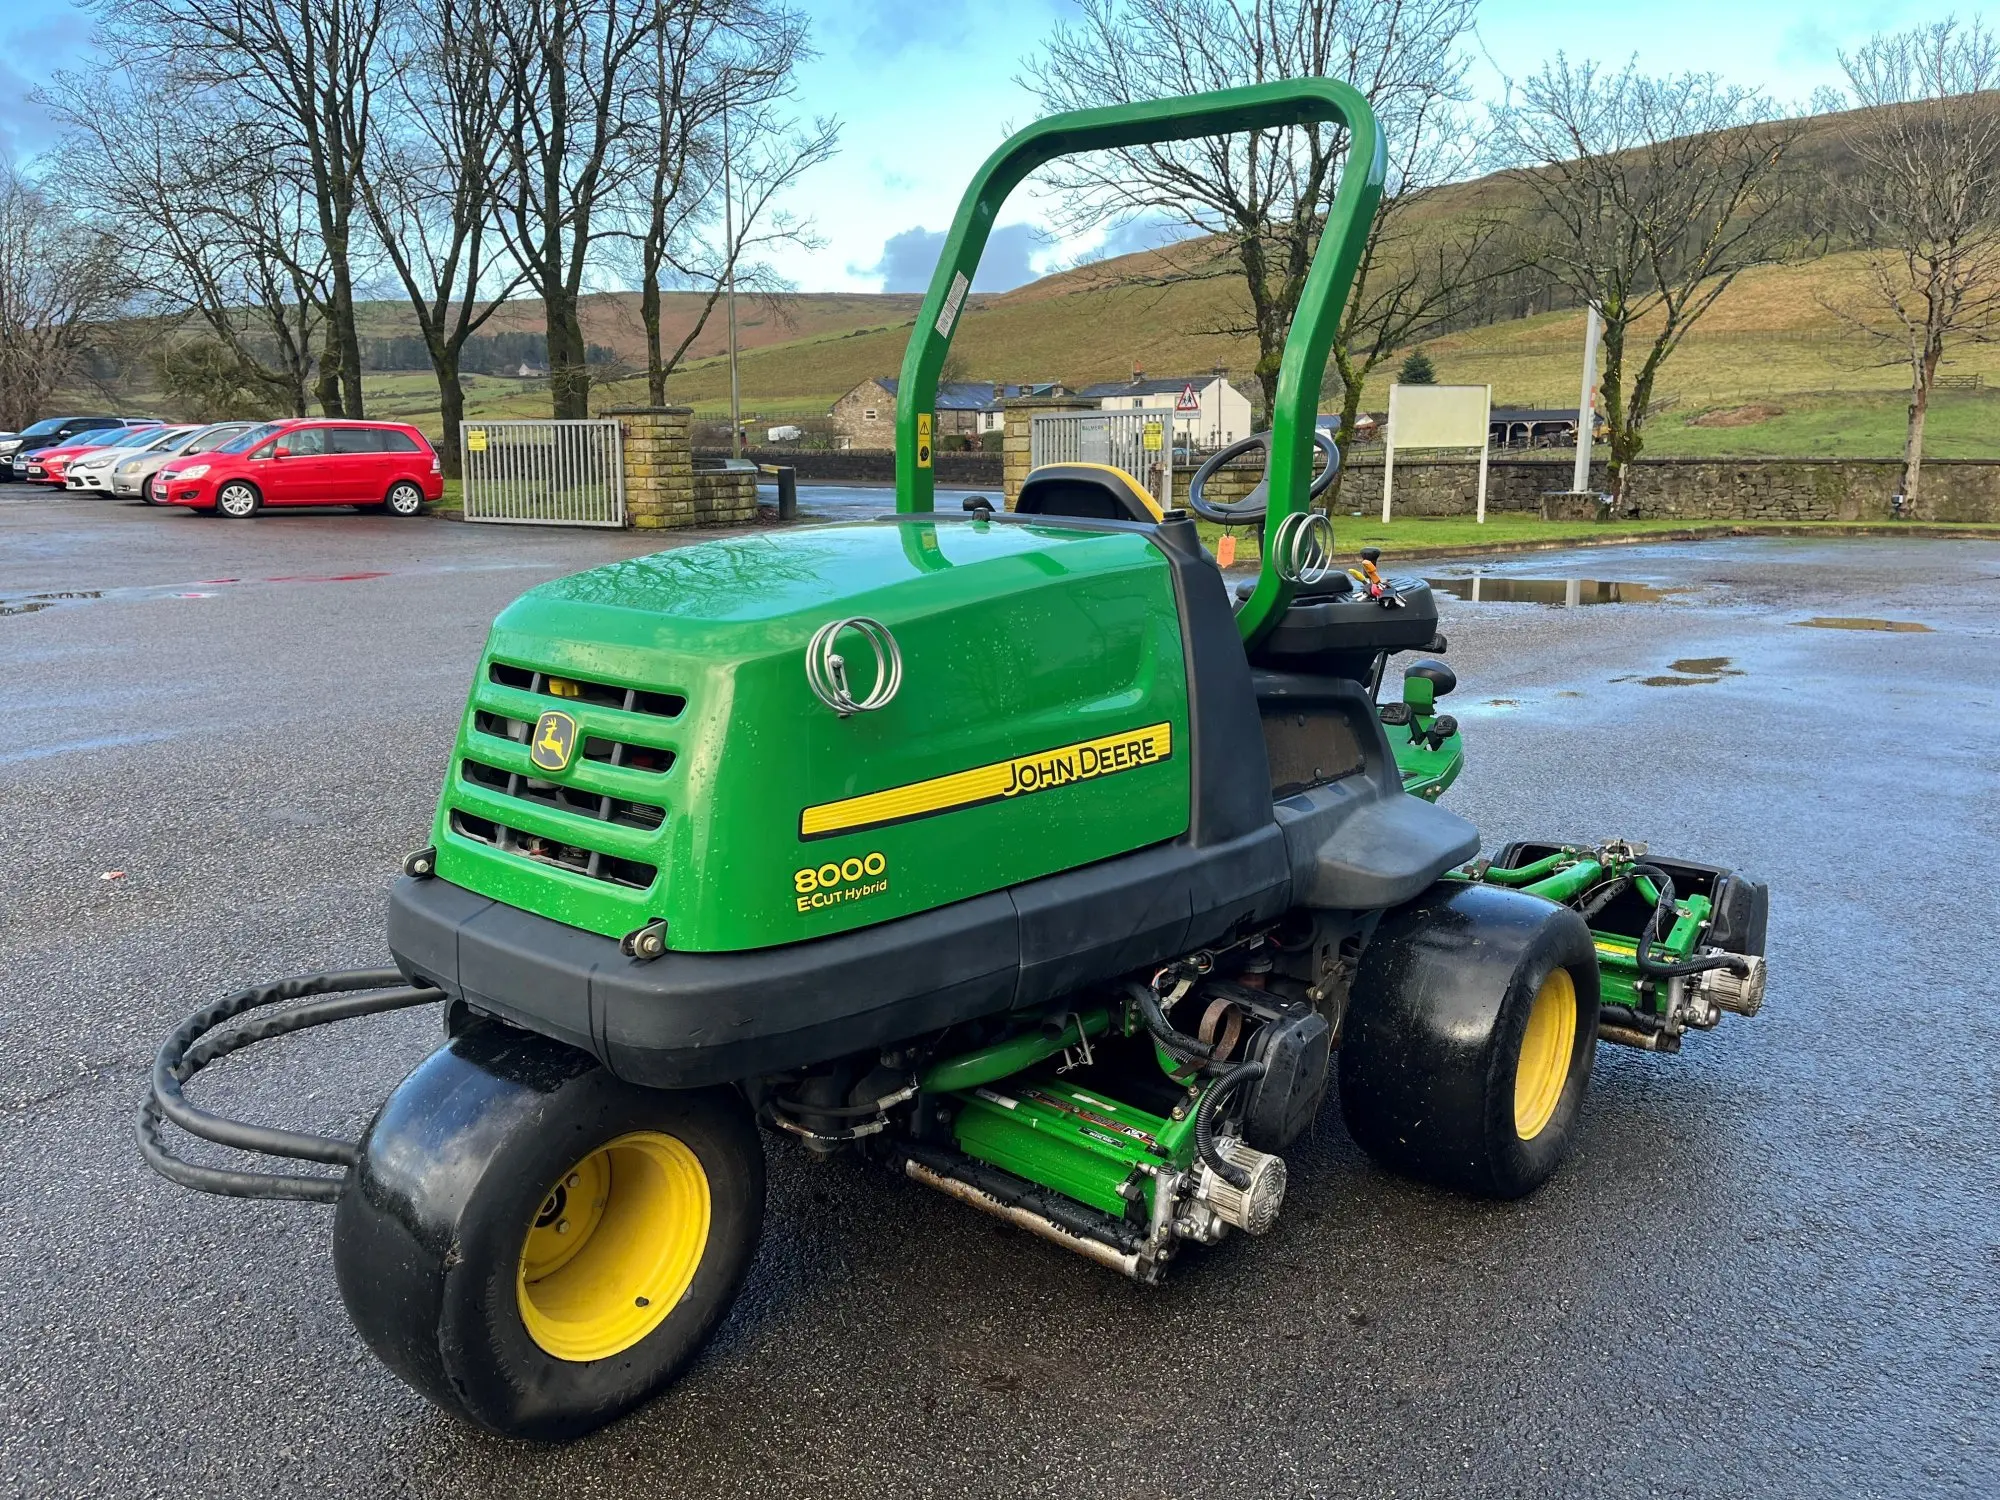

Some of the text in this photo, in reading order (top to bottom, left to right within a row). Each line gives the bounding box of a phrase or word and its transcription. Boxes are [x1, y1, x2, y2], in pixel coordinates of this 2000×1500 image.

[1003, 737, 1156, 792] JOHN DEERE
[794, 852, 886, 893] 8000
[845, 879, 887, 900] Hybrid
